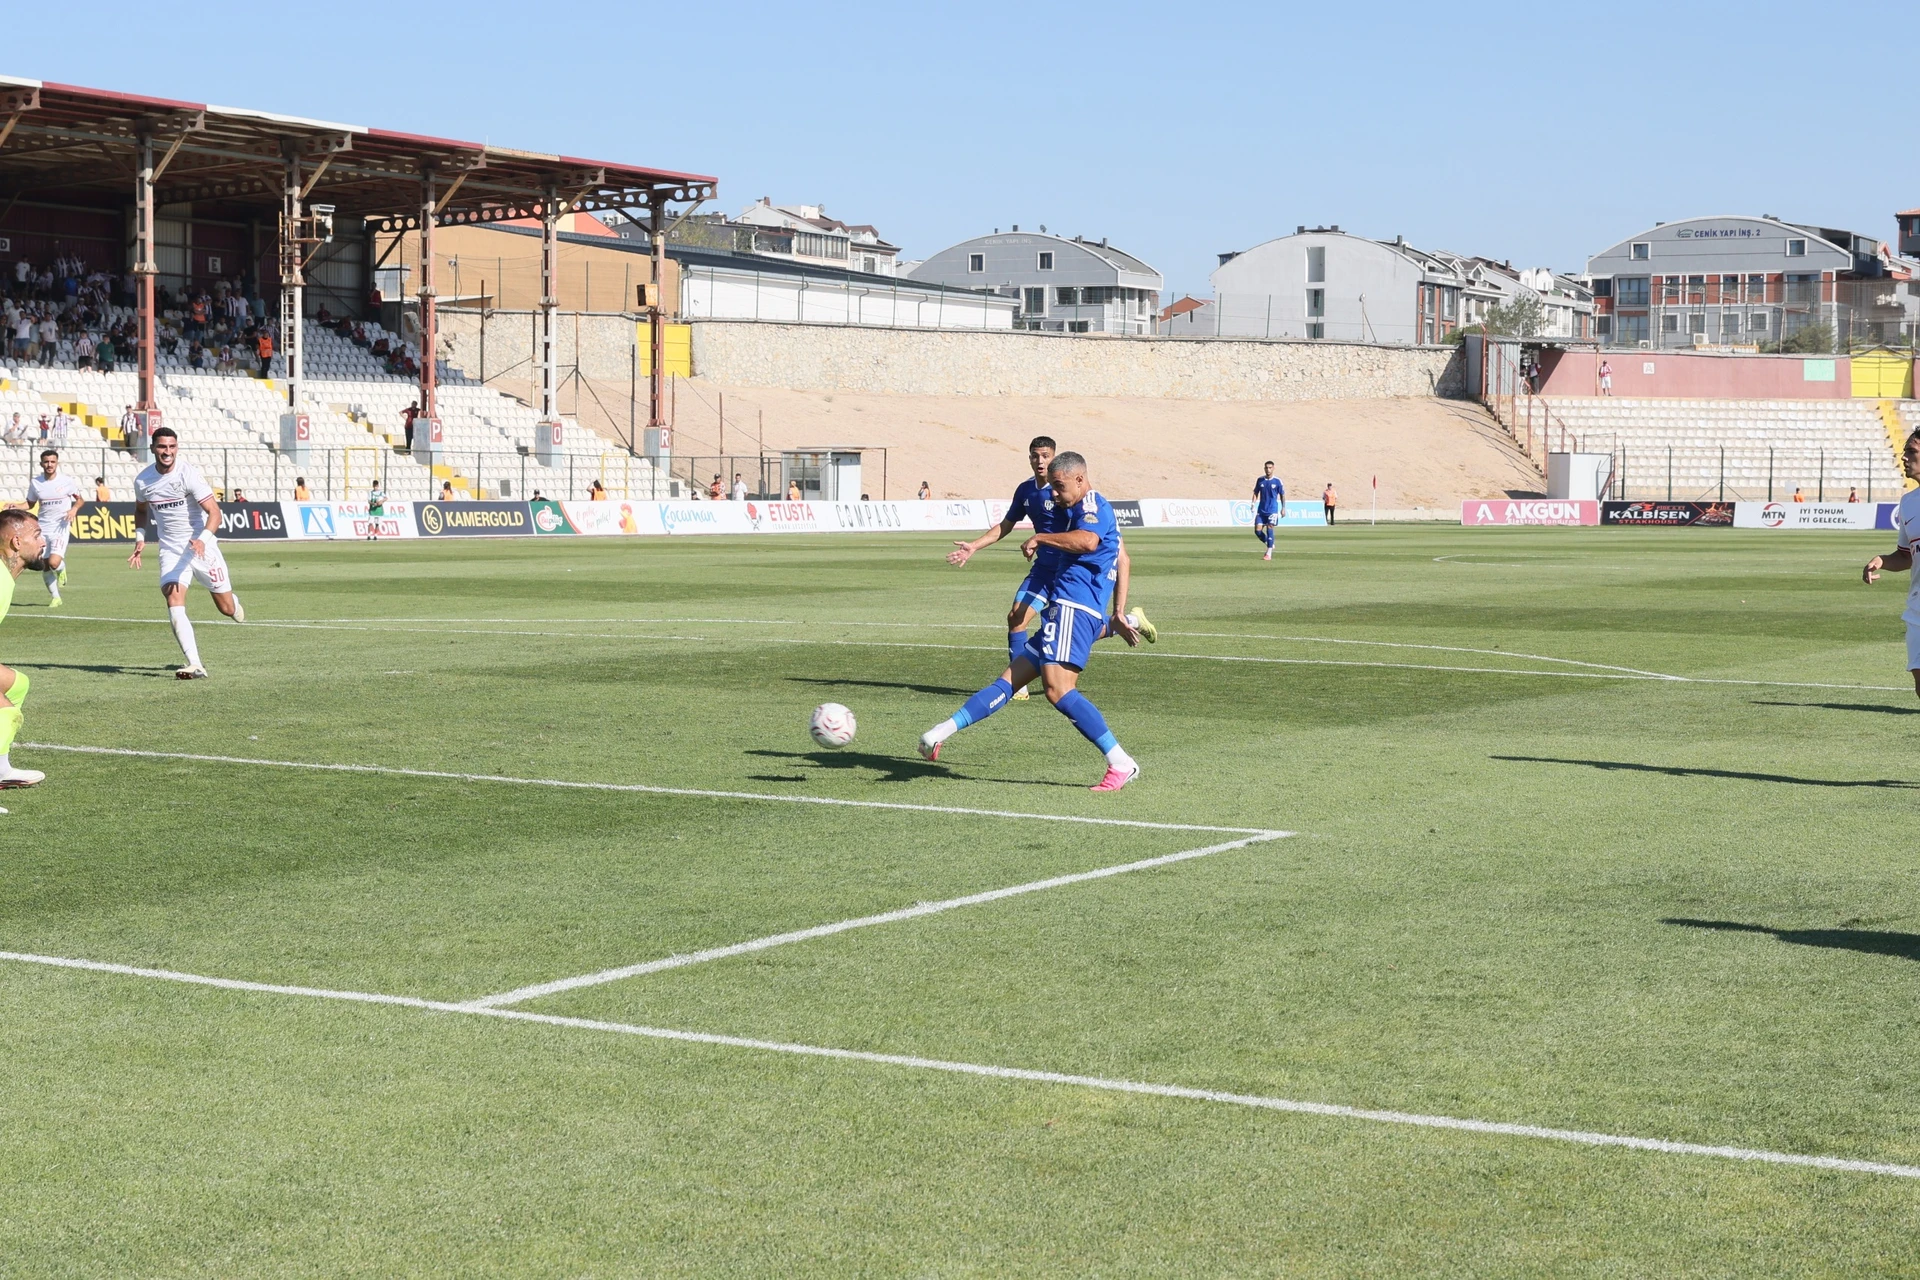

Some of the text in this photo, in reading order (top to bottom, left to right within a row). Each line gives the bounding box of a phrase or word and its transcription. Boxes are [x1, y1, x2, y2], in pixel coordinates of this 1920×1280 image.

[1720, 229, 1737, 237] YAPI
[1756, 228, 1761, 236] 2
[212, 259, 218, 271] E
[1645, 363, 1653, 373] A
[299, 418, 308, 438] S
[433, 422, 440, 439] P
[554, 427, 561, 443] O
[661, 428, 669, 446] R
[156, 500, 184, 510] METRO
[338, 505, 407, 519] ASLALAR
[768, 503, 815, 522] ETUSTA
[946, 503, 971, 516] ALTIN
[1504, 502, 1580, 520] AKGÜN
[445, 511, 524, 528] KAMERGOLD
[658, 502, 717, 530] Kocaman
[835, 504, 901, 528] COMPASS
[1609, 510, 1690, 520] KALBİŞEN
[1761, 510, 1786, 520] MTN
[1044, 622, 1056, 642] 9
